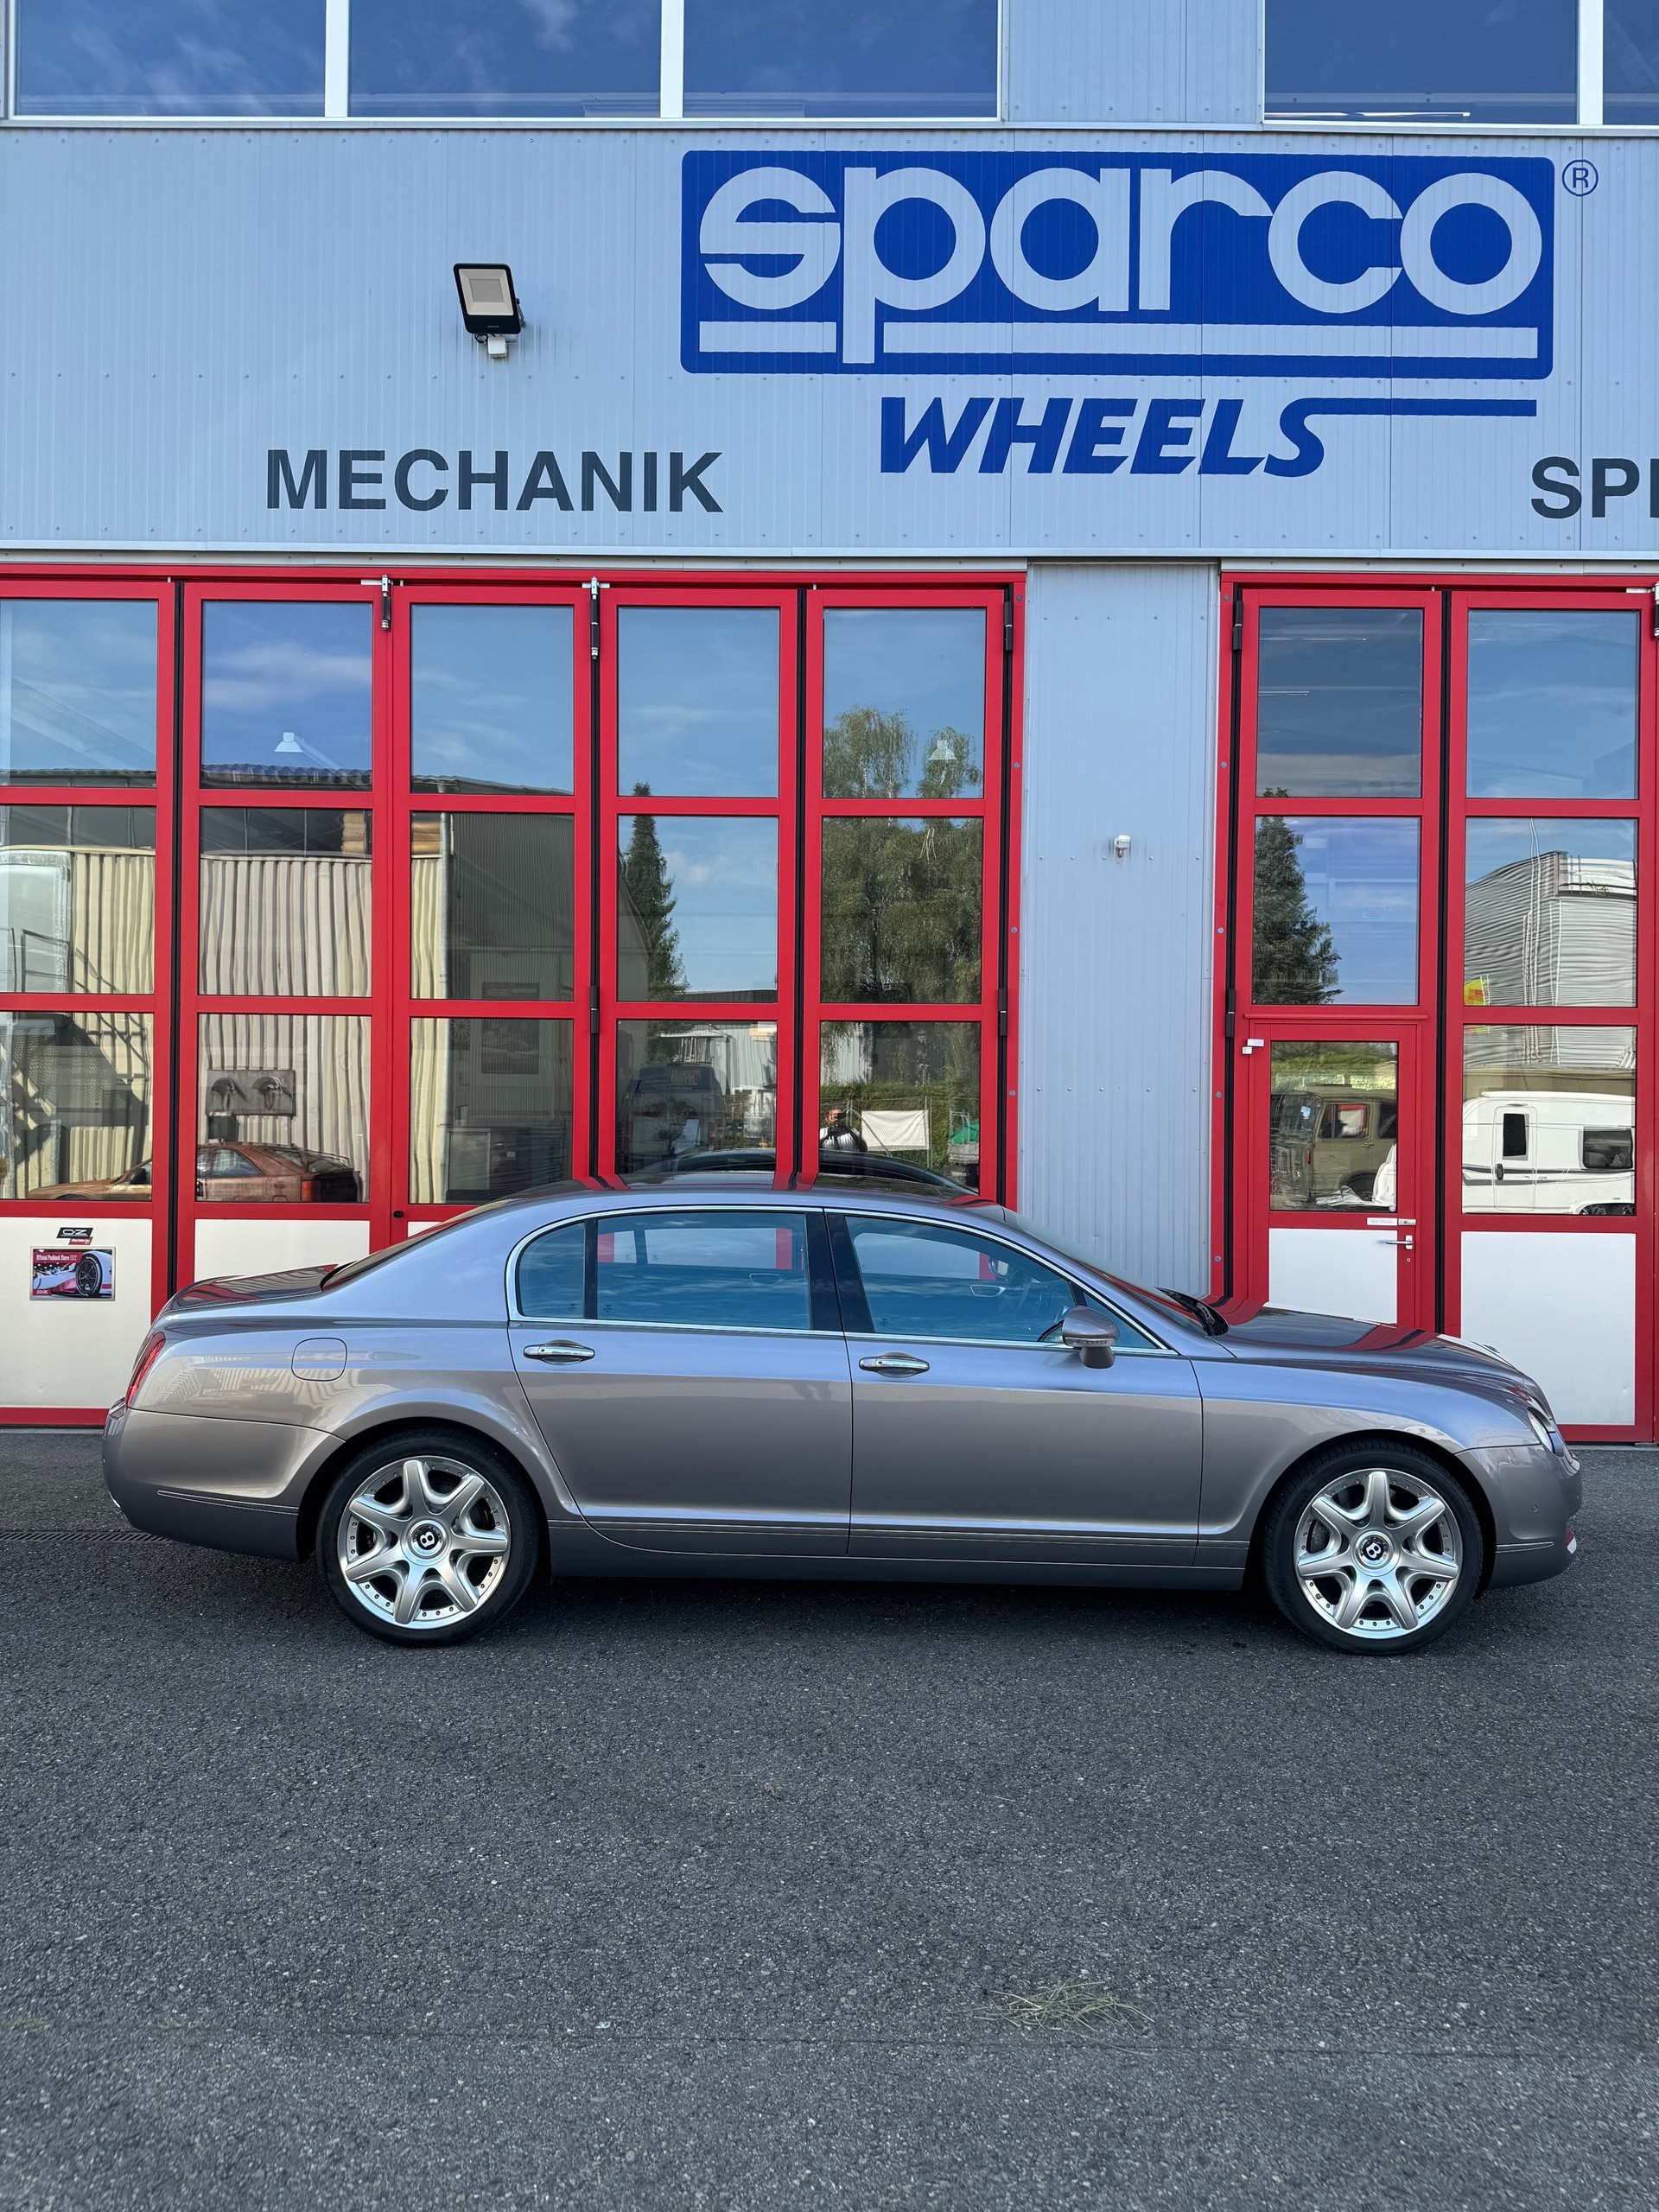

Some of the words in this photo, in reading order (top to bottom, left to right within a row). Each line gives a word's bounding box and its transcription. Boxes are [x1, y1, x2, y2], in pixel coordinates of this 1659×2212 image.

[699, 166, 1542, 364] sparco
[880, 397, 1537, 478] WHEELS
[266, 448, 724, 513] MECHANIK
[1530, 456, 1659, 519] SP
